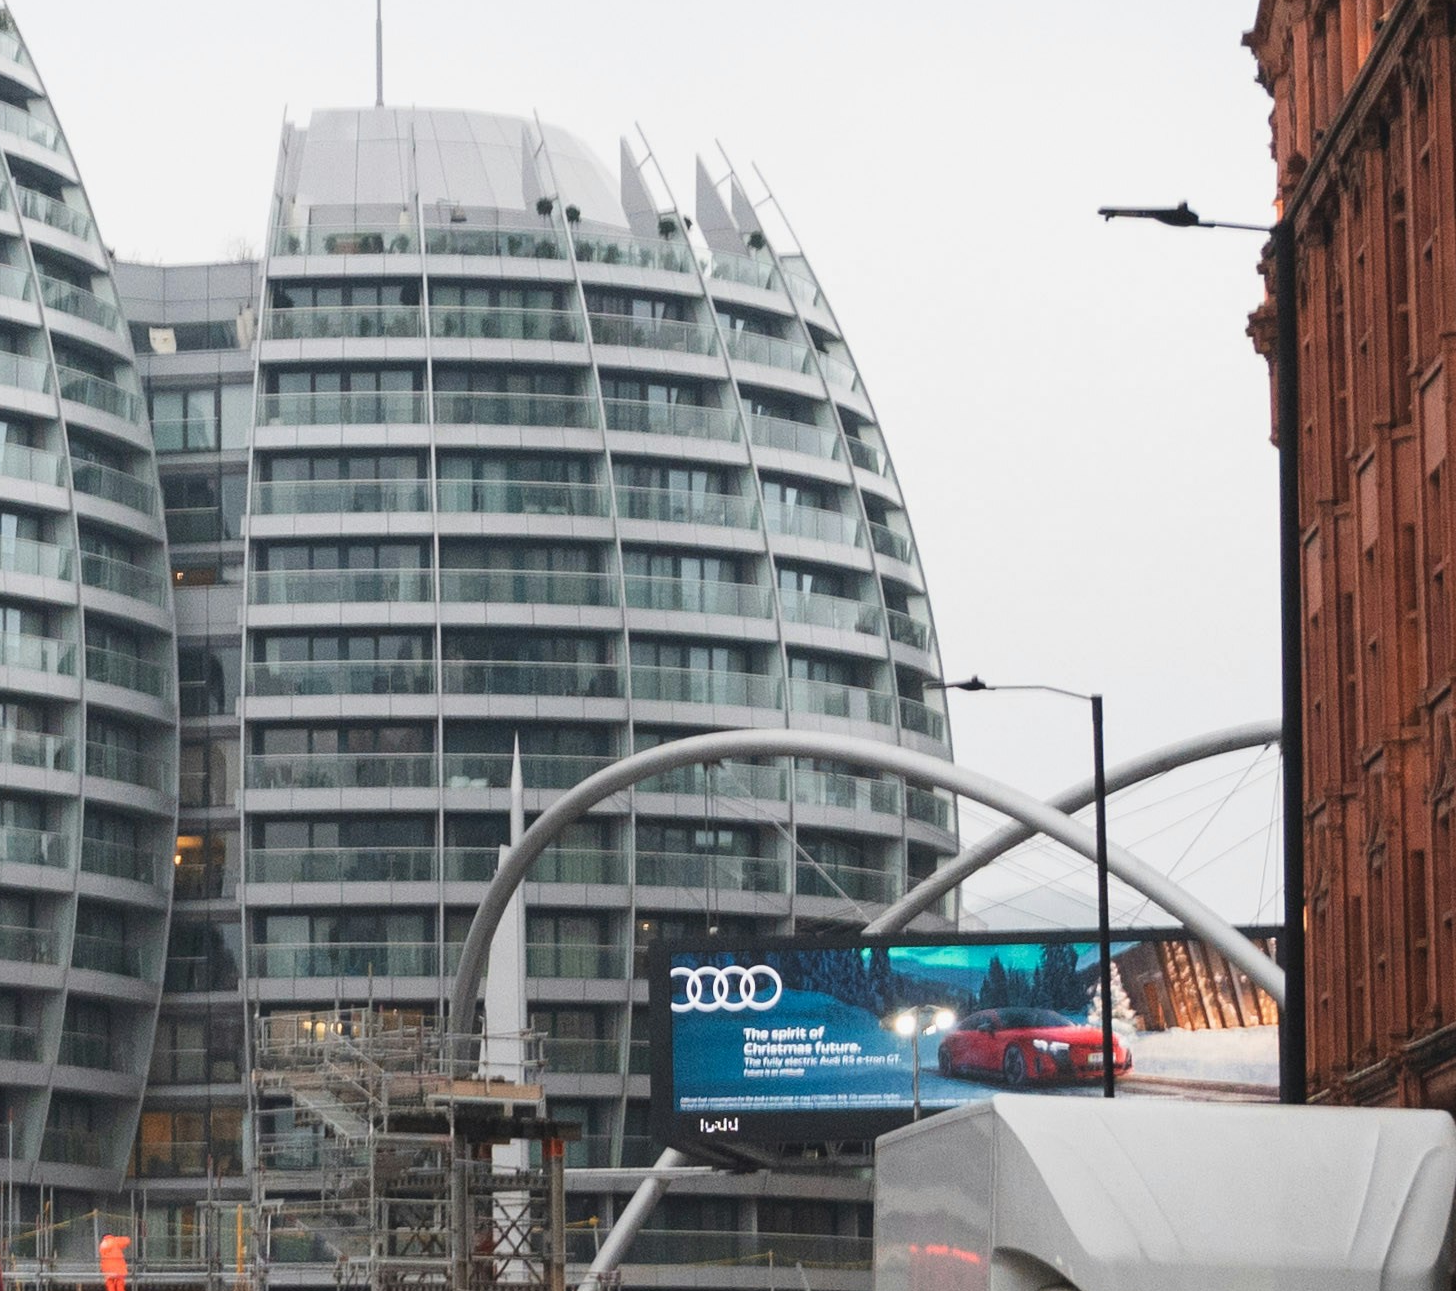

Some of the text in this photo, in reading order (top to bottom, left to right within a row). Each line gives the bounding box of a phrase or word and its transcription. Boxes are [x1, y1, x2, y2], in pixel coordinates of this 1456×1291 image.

[743, 1026, 825, 1043] The spirit of
[743, 1043, 812, 1056] Christmas
[744, 1057, 762, 1068] The
[763, 1055, 783, 1069] fully
[784, 1055, 818, 1068] electric
[819, 1055, 841, 1066] Audi
